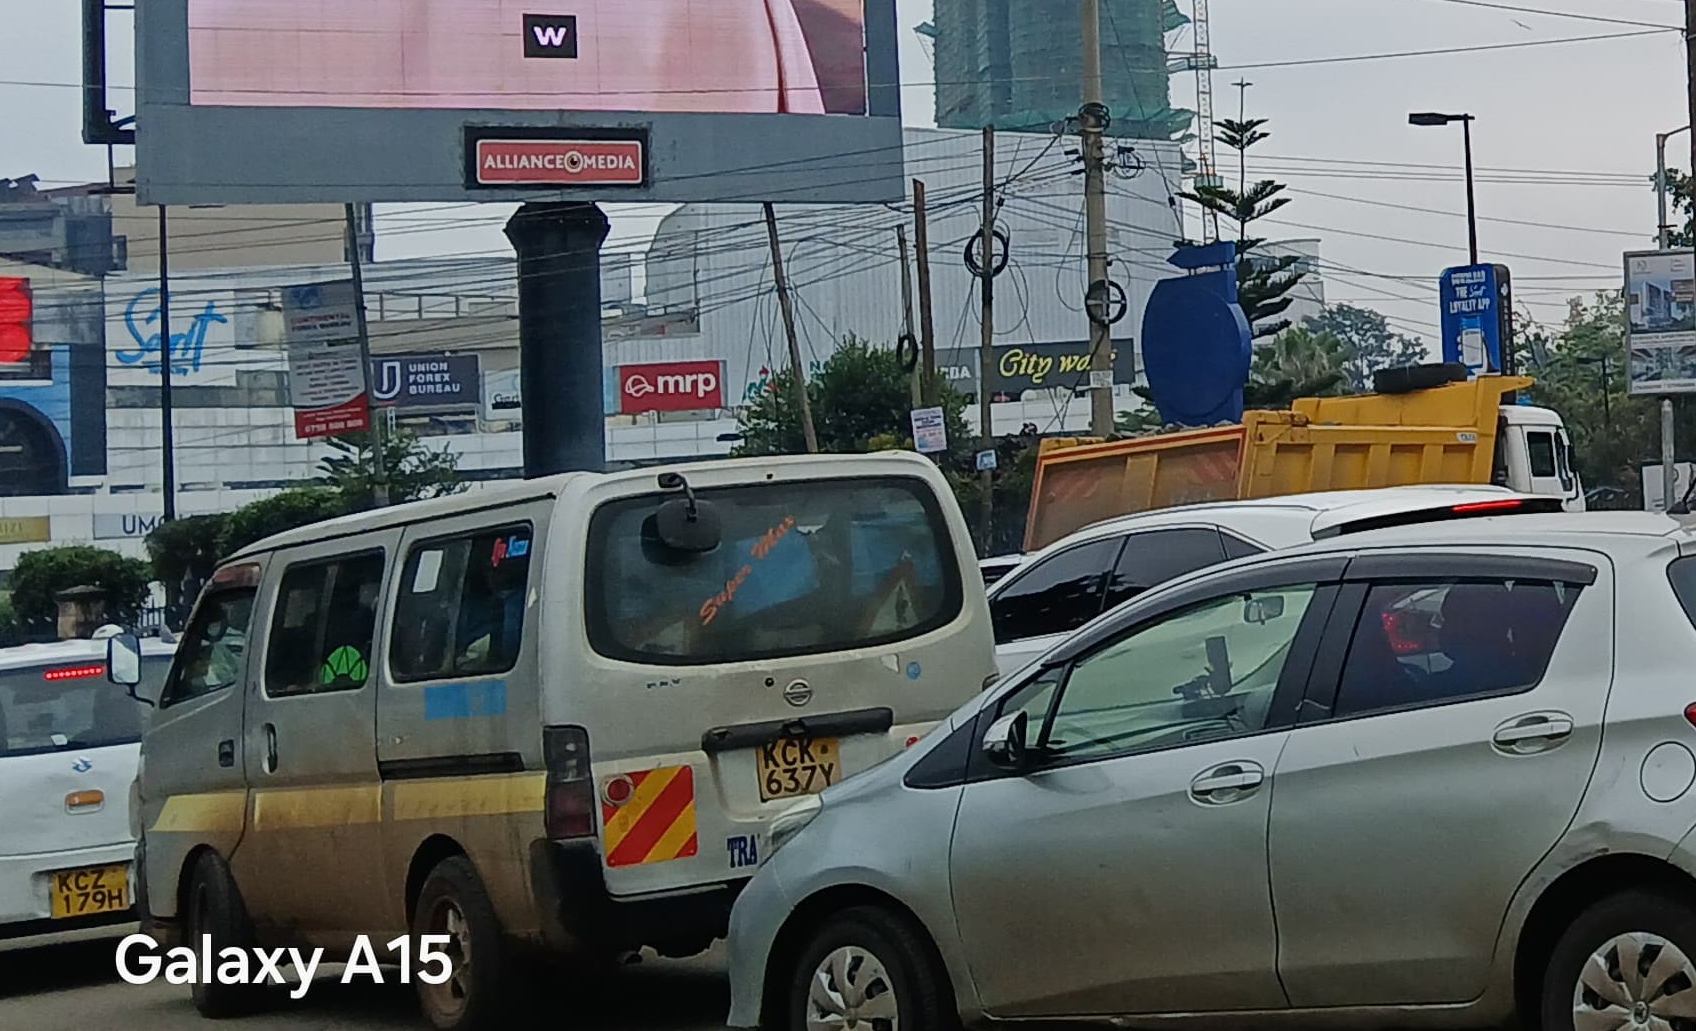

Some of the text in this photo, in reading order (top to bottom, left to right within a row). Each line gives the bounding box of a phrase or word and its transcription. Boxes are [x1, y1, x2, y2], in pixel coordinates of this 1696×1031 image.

[533, 25, 567, 47] W
[484, 154, 635, 169] ALLIANCE MEDIA
[408, 362, 448, 372] UNION
[408, 373, 450, 383] FOREX
[1000, 349, 1053, 384] City
[408, 383, 461, 394] BUREAU
[657, 373, 716, 397] mrp
[763, 738, 815, 770] KCK
[766, 761, 835, 795] 637Y
[58, 870, 106, 894] KCZ
[63, 884, 124, 915] 179H
